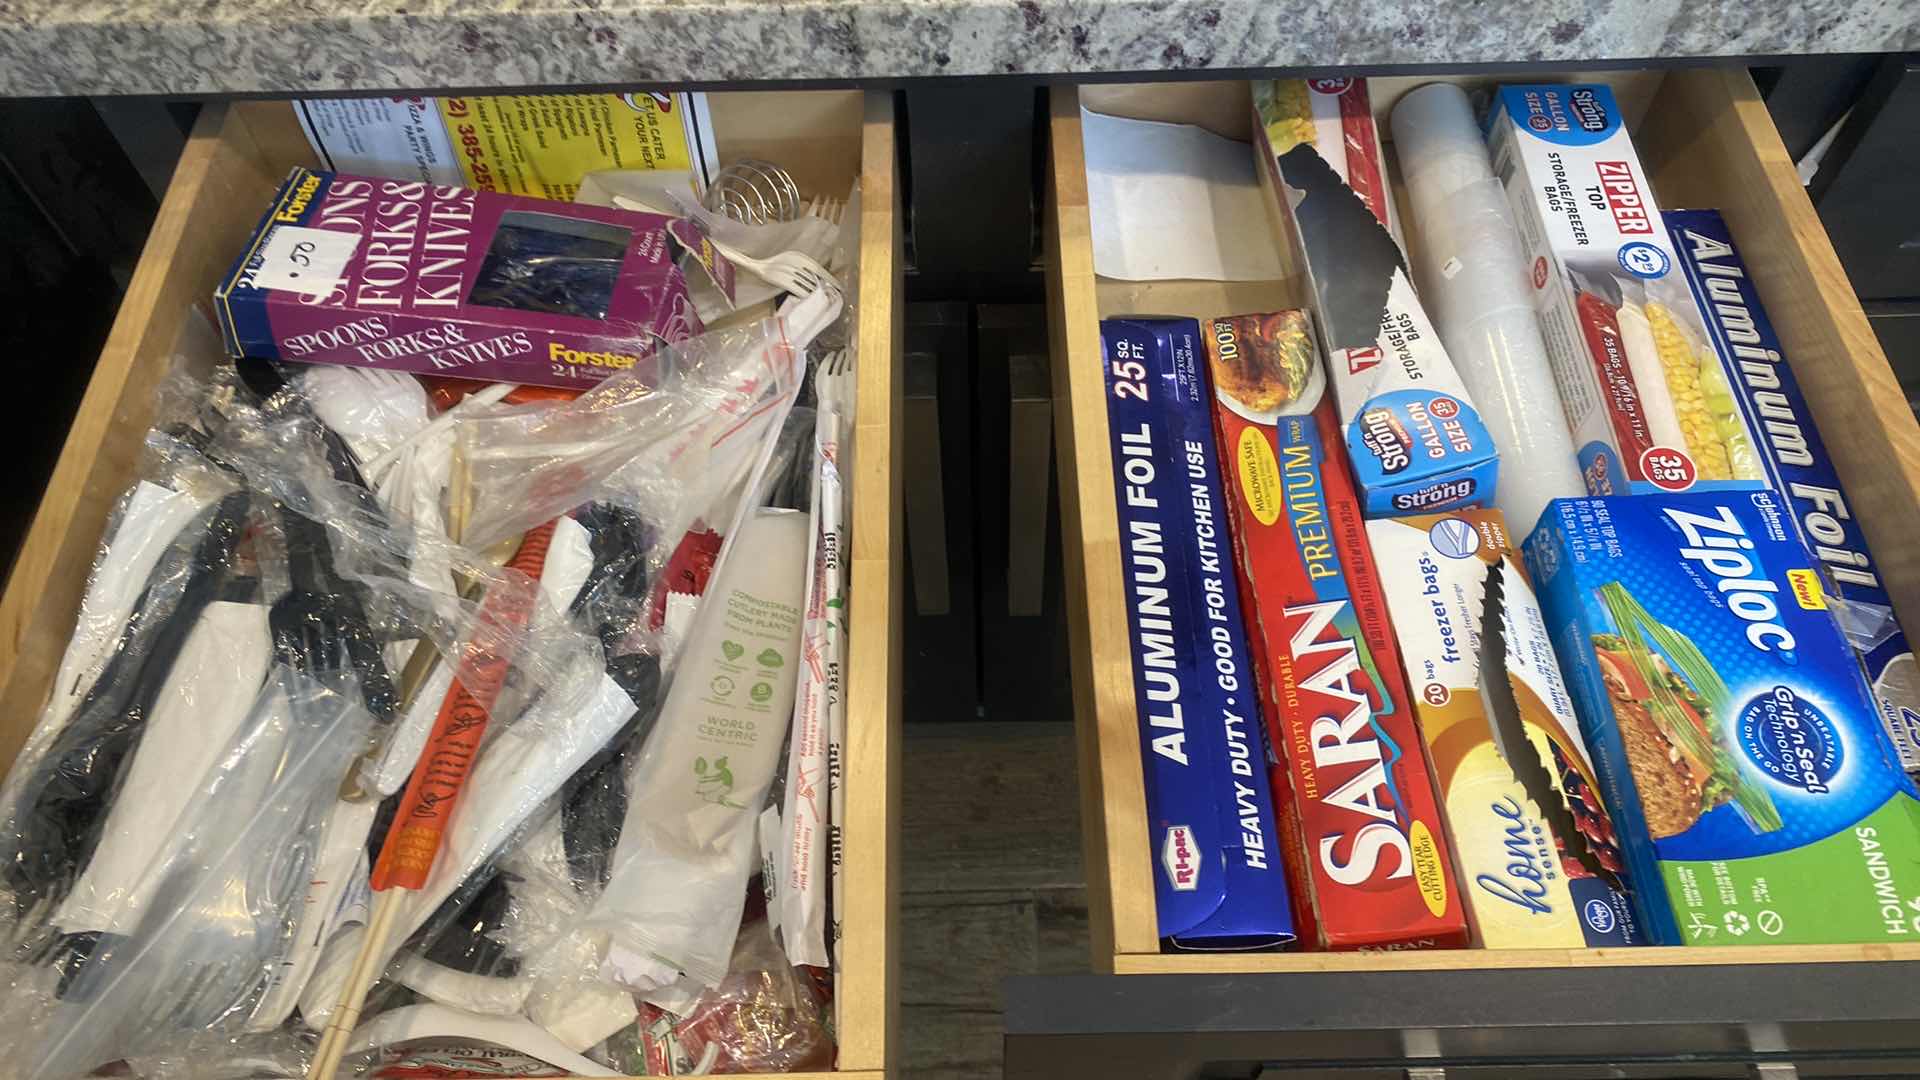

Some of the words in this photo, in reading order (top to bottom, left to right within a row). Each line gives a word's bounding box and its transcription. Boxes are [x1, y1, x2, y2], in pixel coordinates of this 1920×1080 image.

[646, 112, 657, 126] US
[1525, 92, 1543, 115] SIZE
[1545, 91, 1570, 132] GALLON
[1573, 91, 1604, 129] Strong
[634, 116, 649, 144] YOUR
[651, 129, 666, 160] CATER
[641, 146, 656, 170] NEXT
[274, 174, 322, 222] Forster
[1544, 186, 1563, 211] BAGS
[1548, 152, 1589, 245] STORAGE/FREEZER
[1585, 185, 1607, 211] TOP
[1599, 163, 1650, 233] ZIPPER
[412, 185, 478, 309] KNIVES
[284, 316, 390, 356] SPOONS
[1396, 312, 1420, 341] BAGS
[426, 331, 534, 369] KNIVES
[548, 342, 638, 370] Forster
[1217, 333, 1238, 361] 100
[1608, 348, 1621, 368] BAGS
[1112, 361, 1149, 401] 25
[1684, 228, 1815, 468] Aluminum
[1790, 480, 1879, 588] Foil
[1365, 411, 1409, 471] Strong
[1406, 401, 1445, 459] GALLON
[1443, 420, 1471, 452] SIZE
[1121, 423, 1158, 508] FOIL
[1185, 440, 1206, 478] USE
[1243, 440, 1254, 463] SAFE
[1648, 456, 1664, 480] BAGS
[1660, 456, 1687, 481] 35
[1247, 459, 1265, 512] MICROWAVE
[1398, 481, 1470, 509] Strong
[1190, 484, 1221, 573] KITCHEN
[1283, 444, 1338, 581] PREMIUM
[1594, 509, 1611, 524] SEAL
[1601, 525, 1616, 538] TOP
[1480, 521, 1496, 549] double
[1605, 540, 1623, 558] BAGS
[1419, 557, 1441, 596] bags
[1663, 506, 1796, 652] Ziploc
[1679, 562, 1699, 577] seal
[1704, 590, 1724, 608] bags
[1791, 573, 1817, 607] New!
[1204, 578, 1228, 621] FOR
[1129, 521, 1189, 766] ALUMINUM
[1435, 599, 1461, 664] freezer
[1210, 625, 1239, 692] GOOD
[1423, 659, 1435, 680] bags
[1530, 640, 1540, 663] BAGS
[1278, 655, 1299, 708] DURABLE
[1430, 687, 1446, 703] 20
[1550, 687, 1563, 714] QUART
[698, 724, 759, 741] CENTRIC
[707, 715, 755, 730] WORLD
[1744, 725, 1753, 739] ON
[1746, 706, 1761, 722] BAG
[1882, 699, 1902, 734] SQUARE
[1223, 709, 1252, 777] DUTY
[1282, 599, 1414, 886] SARAN
[1292, 720, 1310, 753] DUTY
[1749, 742, 1763, 759] THE
[1763, 700, 1800, 782] Technology
[1803, 709, 1835, 769] UNBEATABLE
[1300, 758, 1318, 800] HEAVY
[1764, 761, 1779, 773] GO
[1795, 747, 1828, 791] Seal
[1233, 782, 1268, 870] HEAVY
[1420, 834, 1432, 858] EDGE
[1476, 795, 1552, 915] home
[1532, 826, 1555, 880] sense
[1427, 860, 1443, 900] CUTTING
[1855, 826, 1908, 935] SANDWICH
